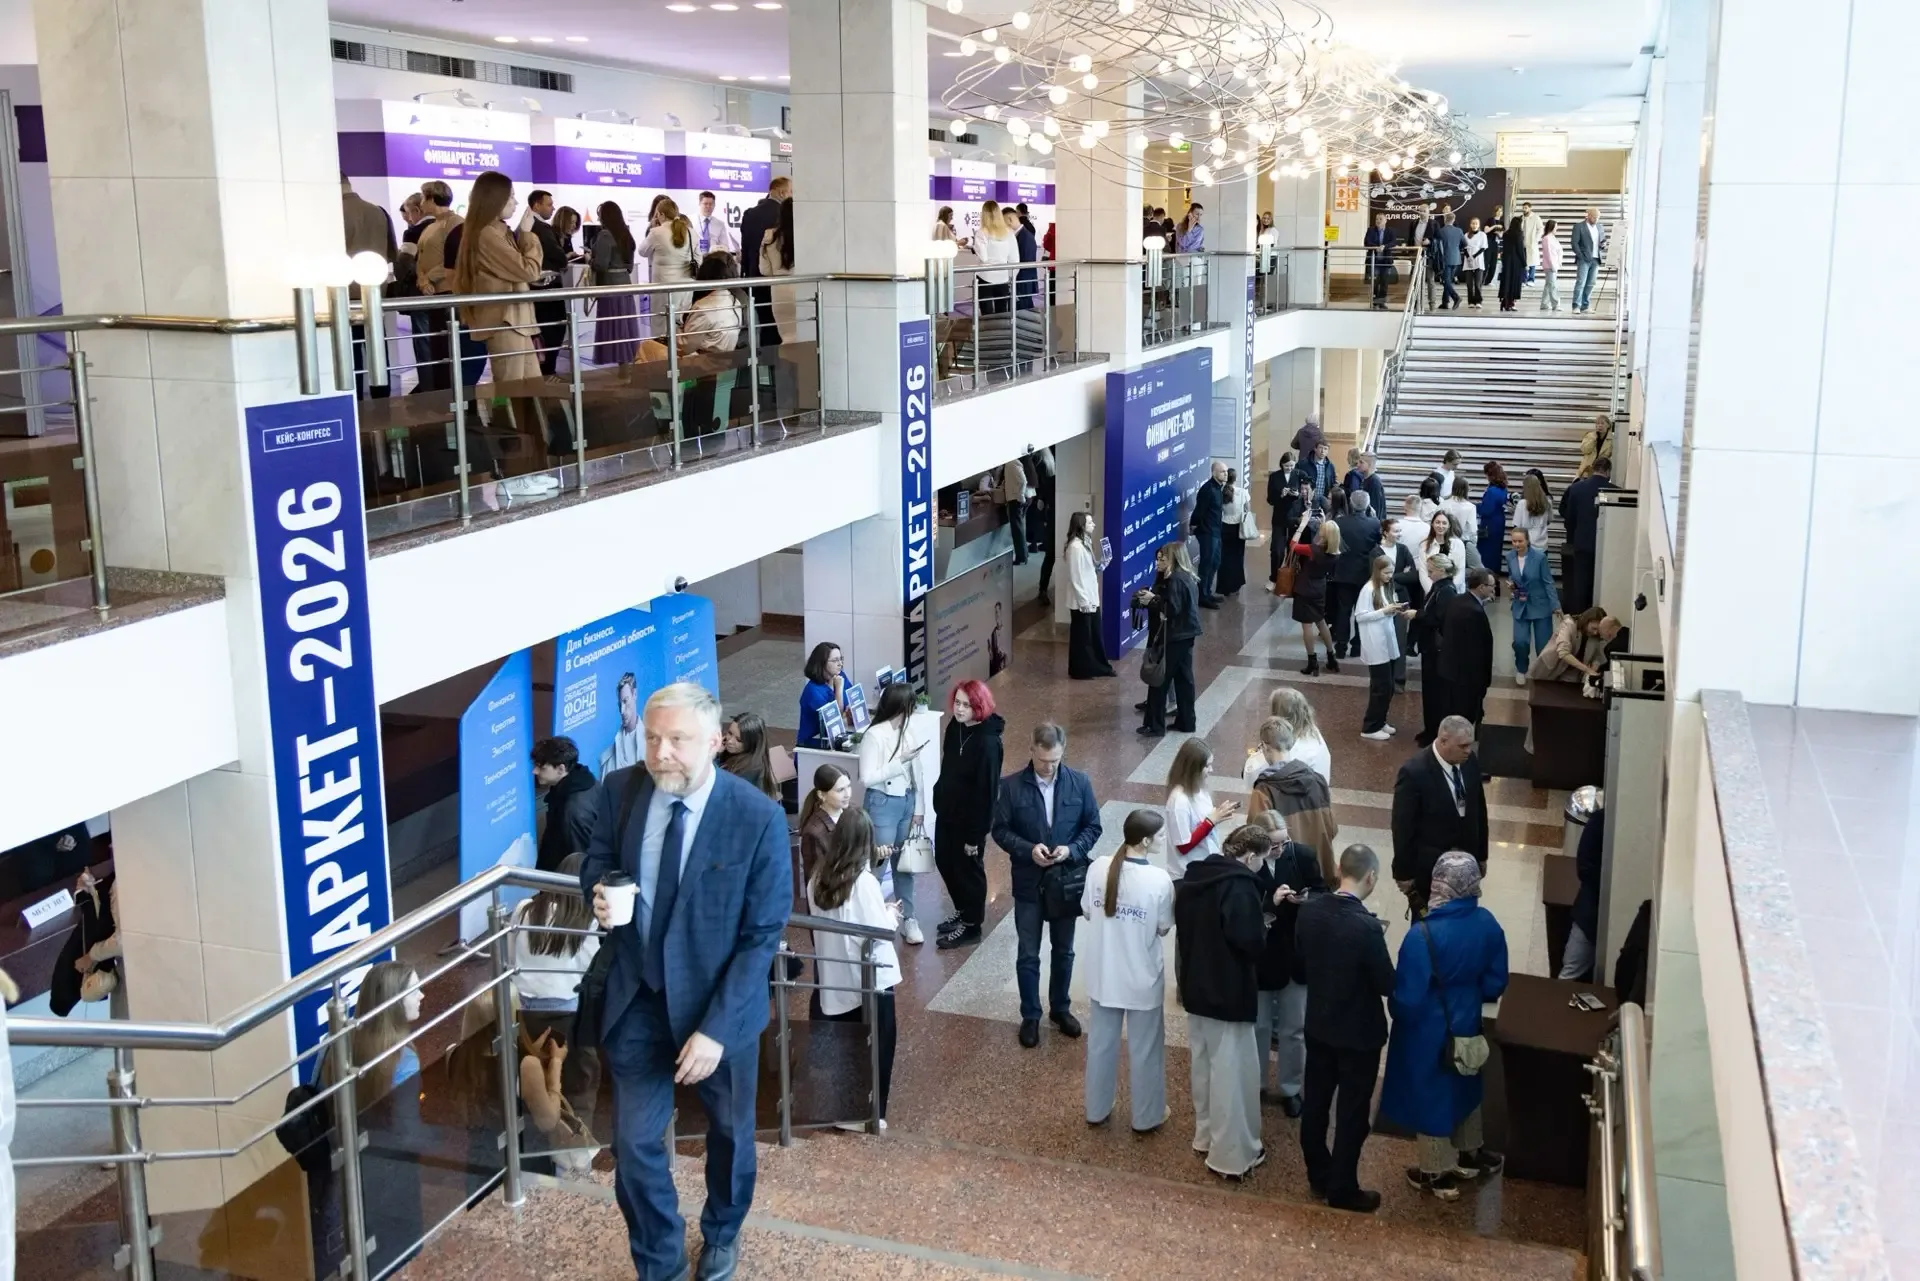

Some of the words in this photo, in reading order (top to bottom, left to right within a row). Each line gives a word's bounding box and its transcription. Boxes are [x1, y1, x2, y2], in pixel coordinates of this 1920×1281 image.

[276, 427, 331, 445] КЕЙС-КОНГРЕСС
[565, 639, 582, 656] Для
[565, 659, 572, 672] В
[564, 690, 597, 718] ФОНД
[1094, 899, 1147, 919] ФАРКЕТ
